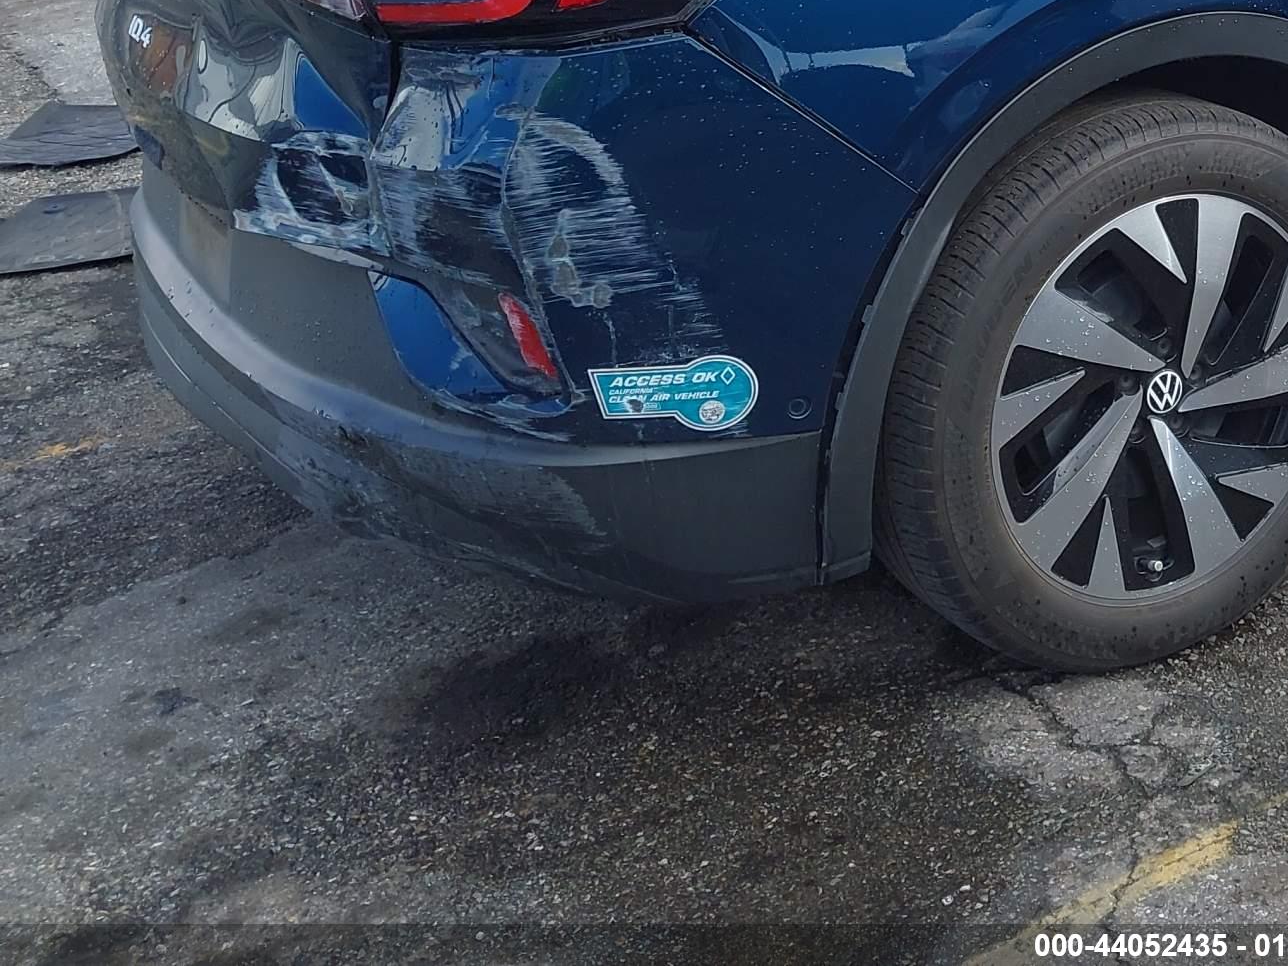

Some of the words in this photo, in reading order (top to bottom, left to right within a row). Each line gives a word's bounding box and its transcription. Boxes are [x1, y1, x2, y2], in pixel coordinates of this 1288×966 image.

[610, 374, 685, 387] ACCESS
[692, 371, 720, 383] OK
[609, 387, 654, 395] CALIFORNIA
[650, 393, 671, 401] AIR
[674, 390, 720, 400] VEHICLE
